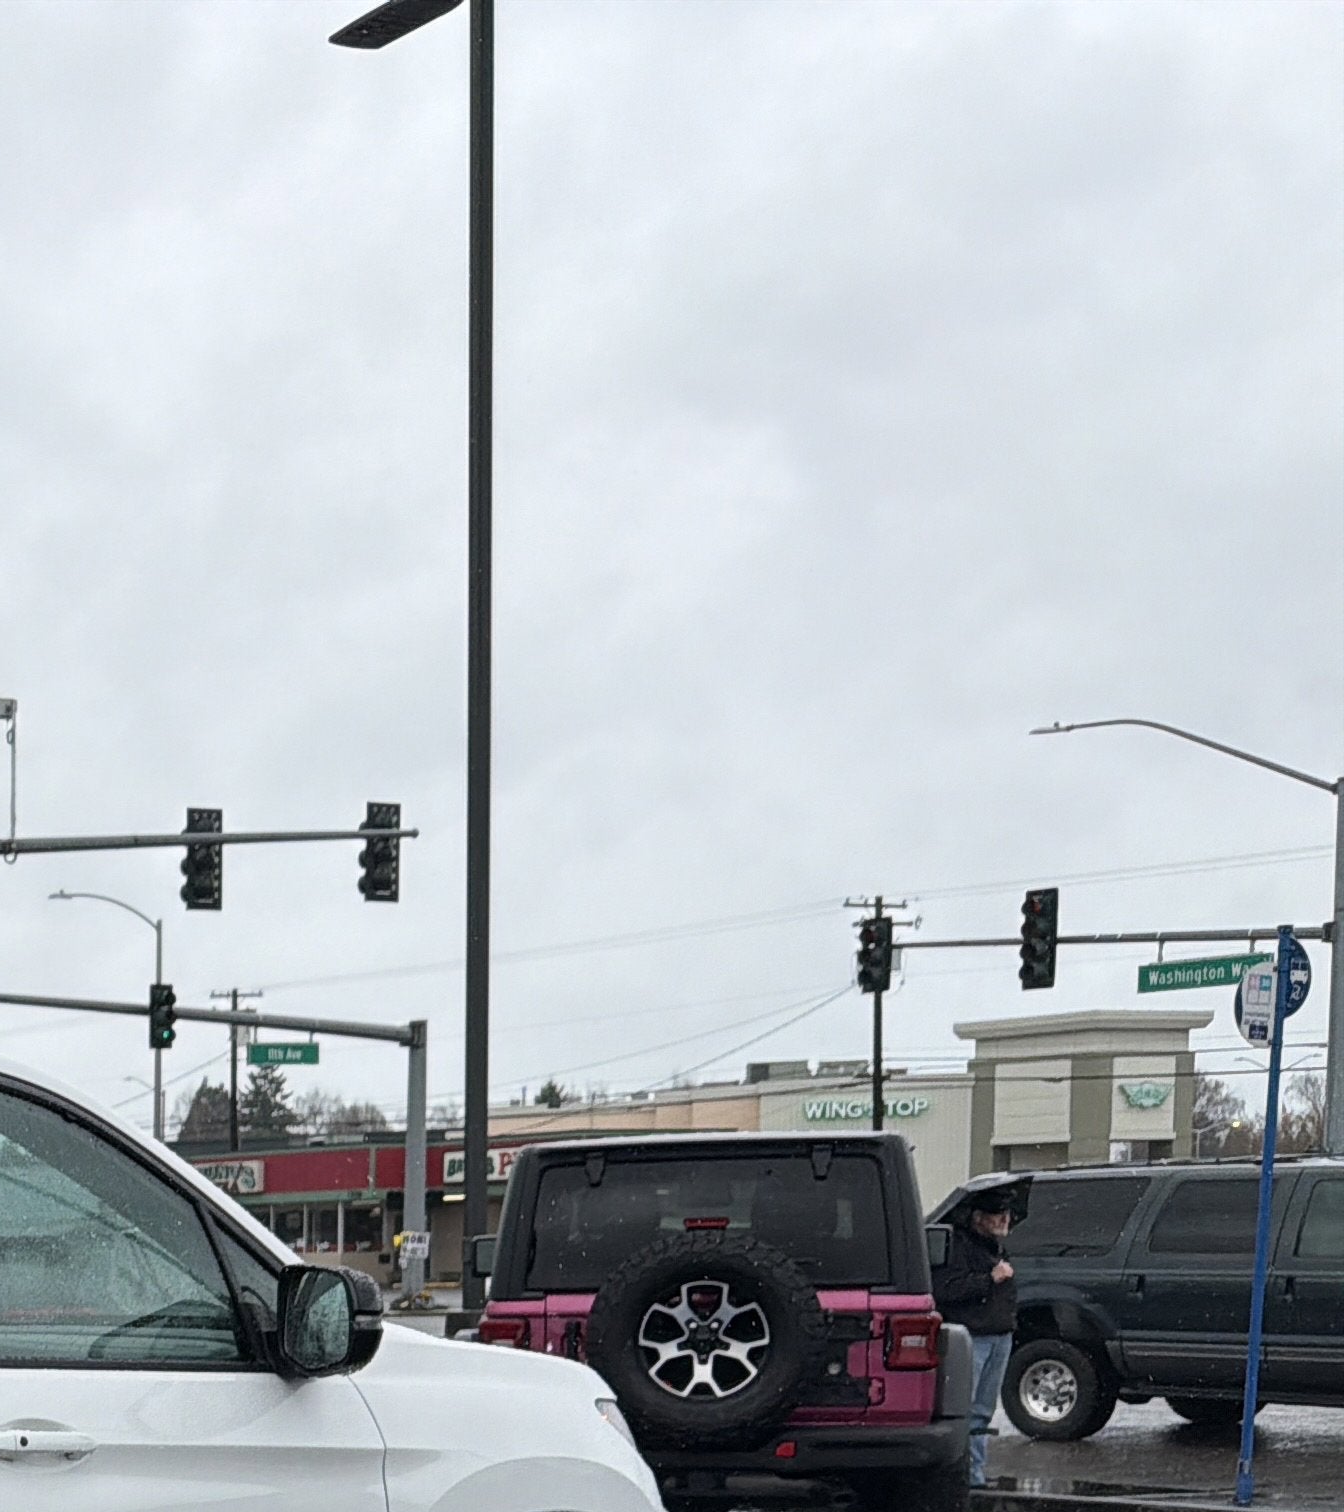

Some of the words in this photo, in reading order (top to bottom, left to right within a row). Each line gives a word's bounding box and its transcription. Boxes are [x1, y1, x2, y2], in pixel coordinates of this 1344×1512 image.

[1148, 966, 1225, 986] Washington
[1232, 961, 1251, 978] Wa
[805, 1098, 928, 1119] WINGTOP
